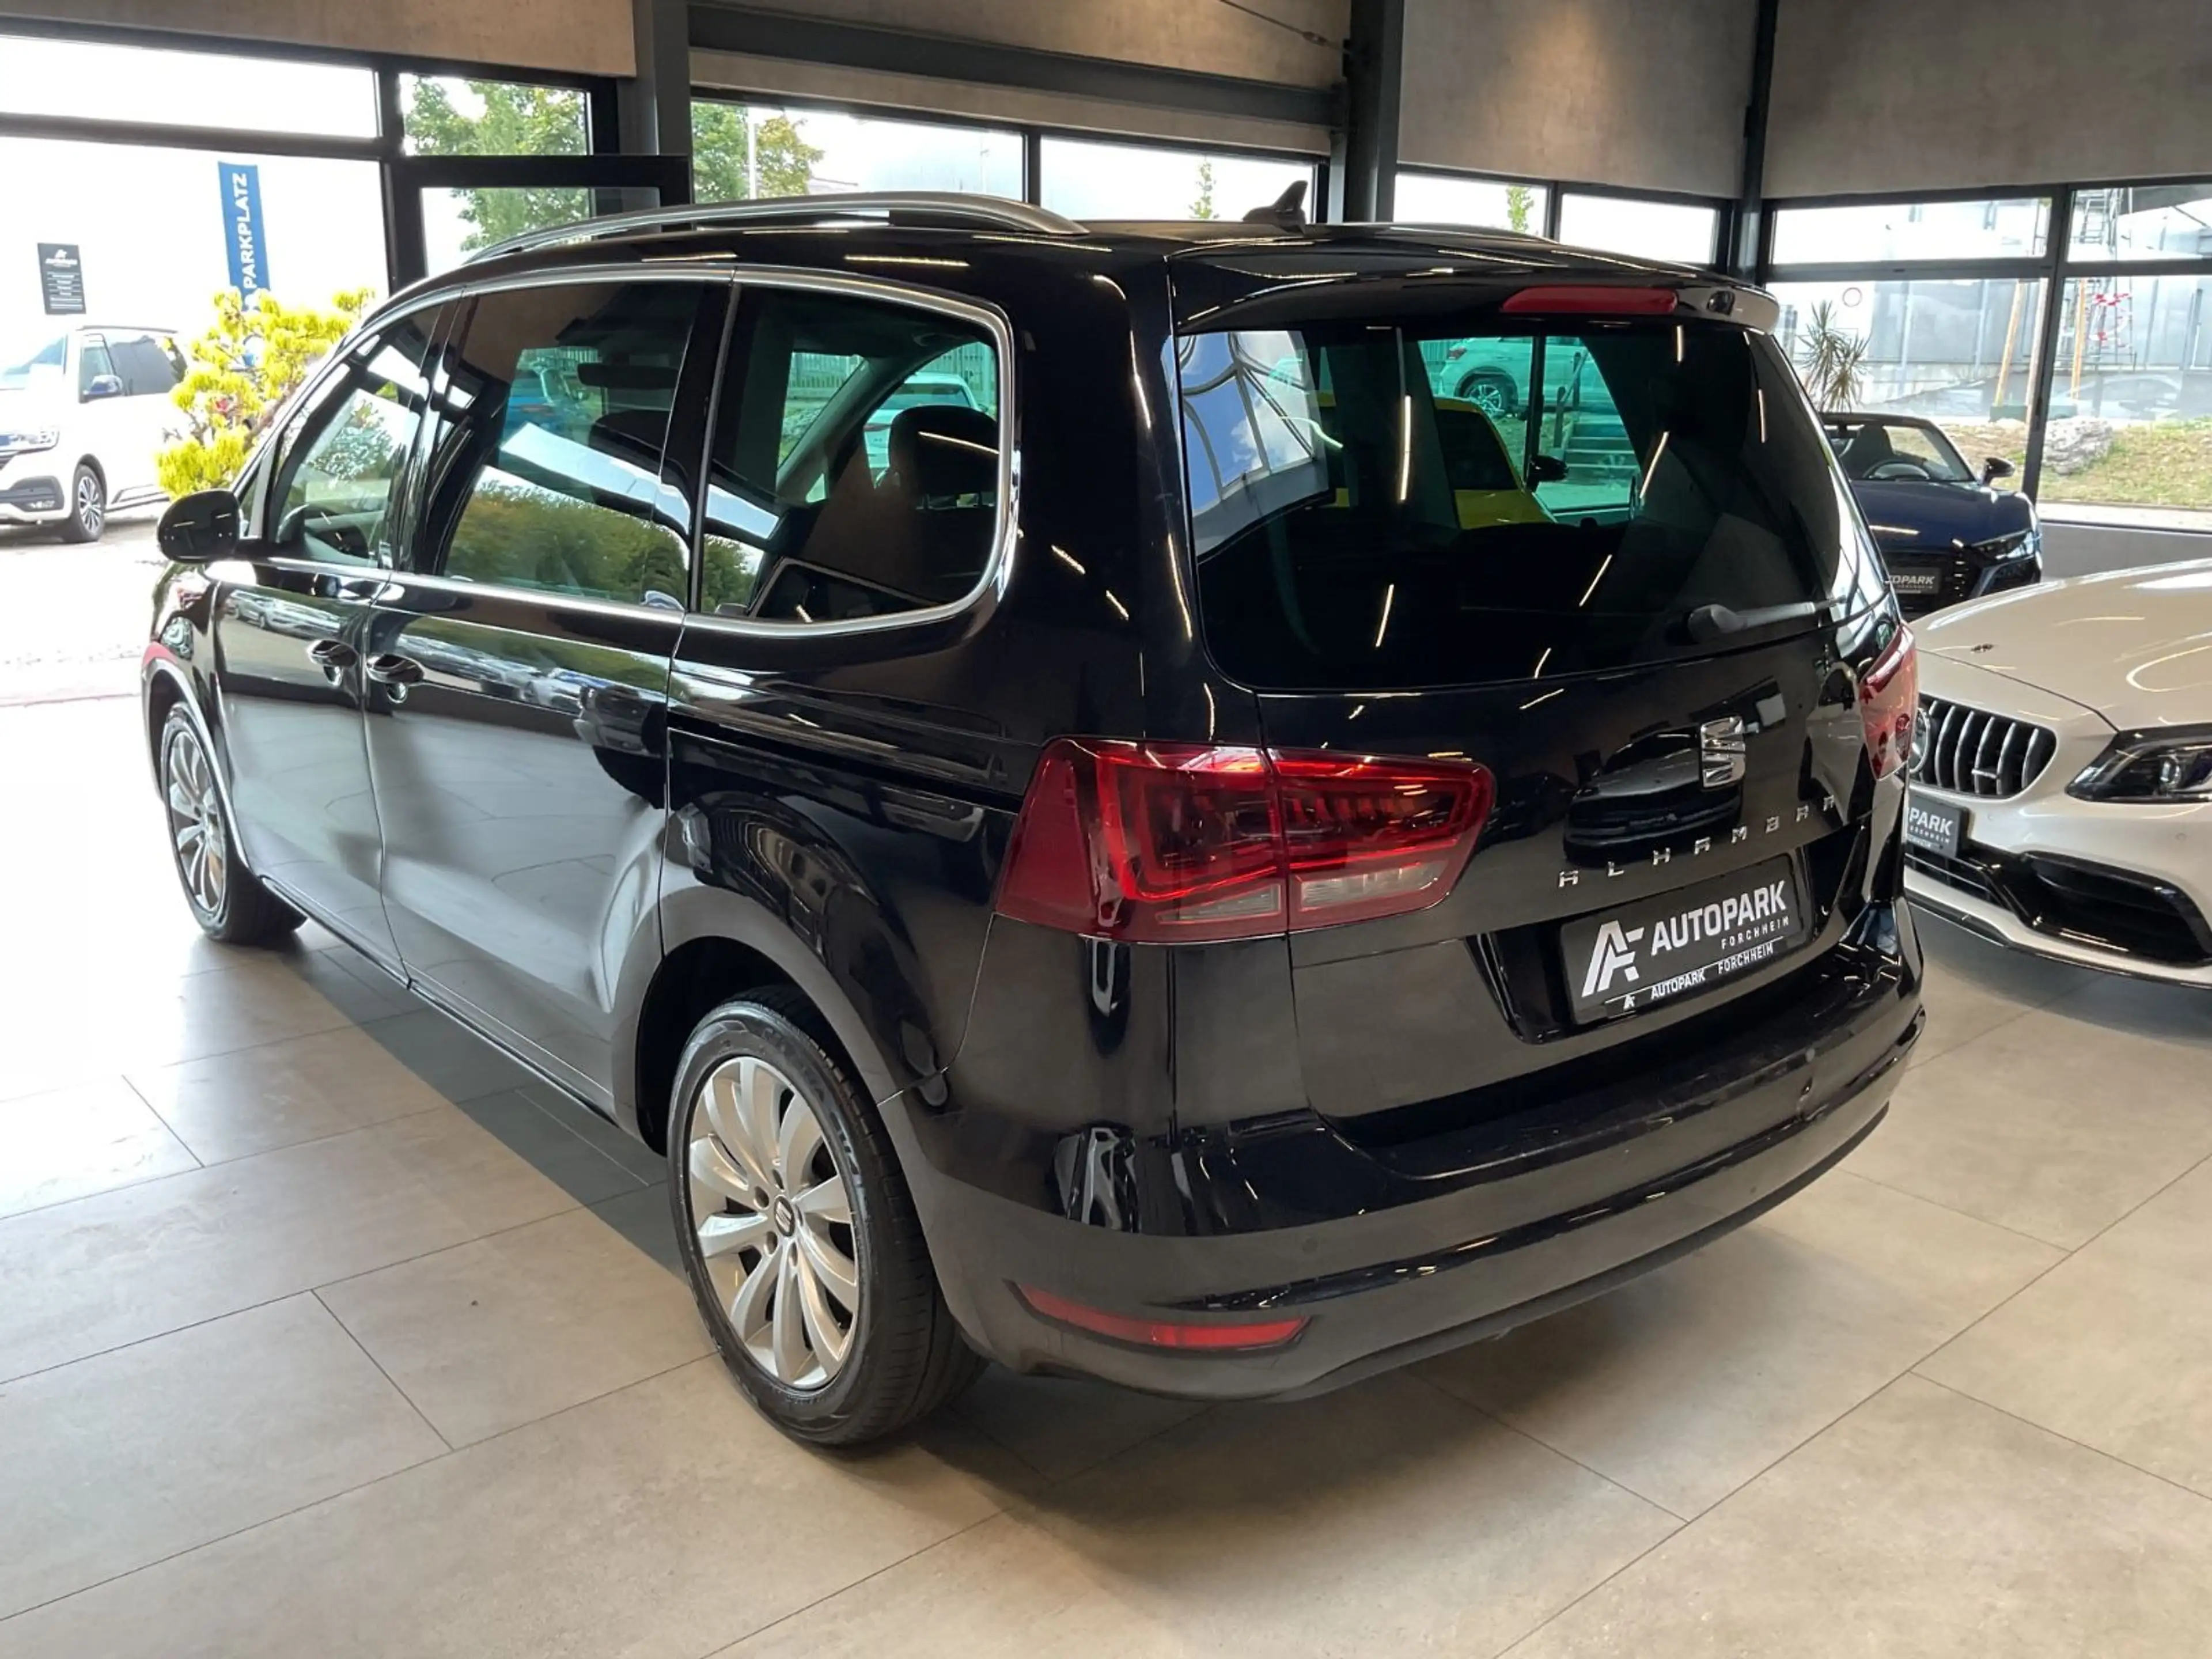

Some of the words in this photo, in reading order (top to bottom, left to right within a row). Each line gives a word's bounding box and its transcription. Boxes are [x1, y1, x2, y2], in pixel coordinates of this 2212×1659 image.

[232, 172, 257, 289] PARKPLATZ
[1558, 794, 1835, 888] ALHAMBRA
[1907, 806, 1953, 836] PARK
[1650, 879, 1787, 957] AUTOPARK
[1721, 915, 1789, 950] FORCHHEIM
[1650, 968, 1706, 1001] AUTOPARK
[1717, 942, 1774, 975] FORCHHEIM
